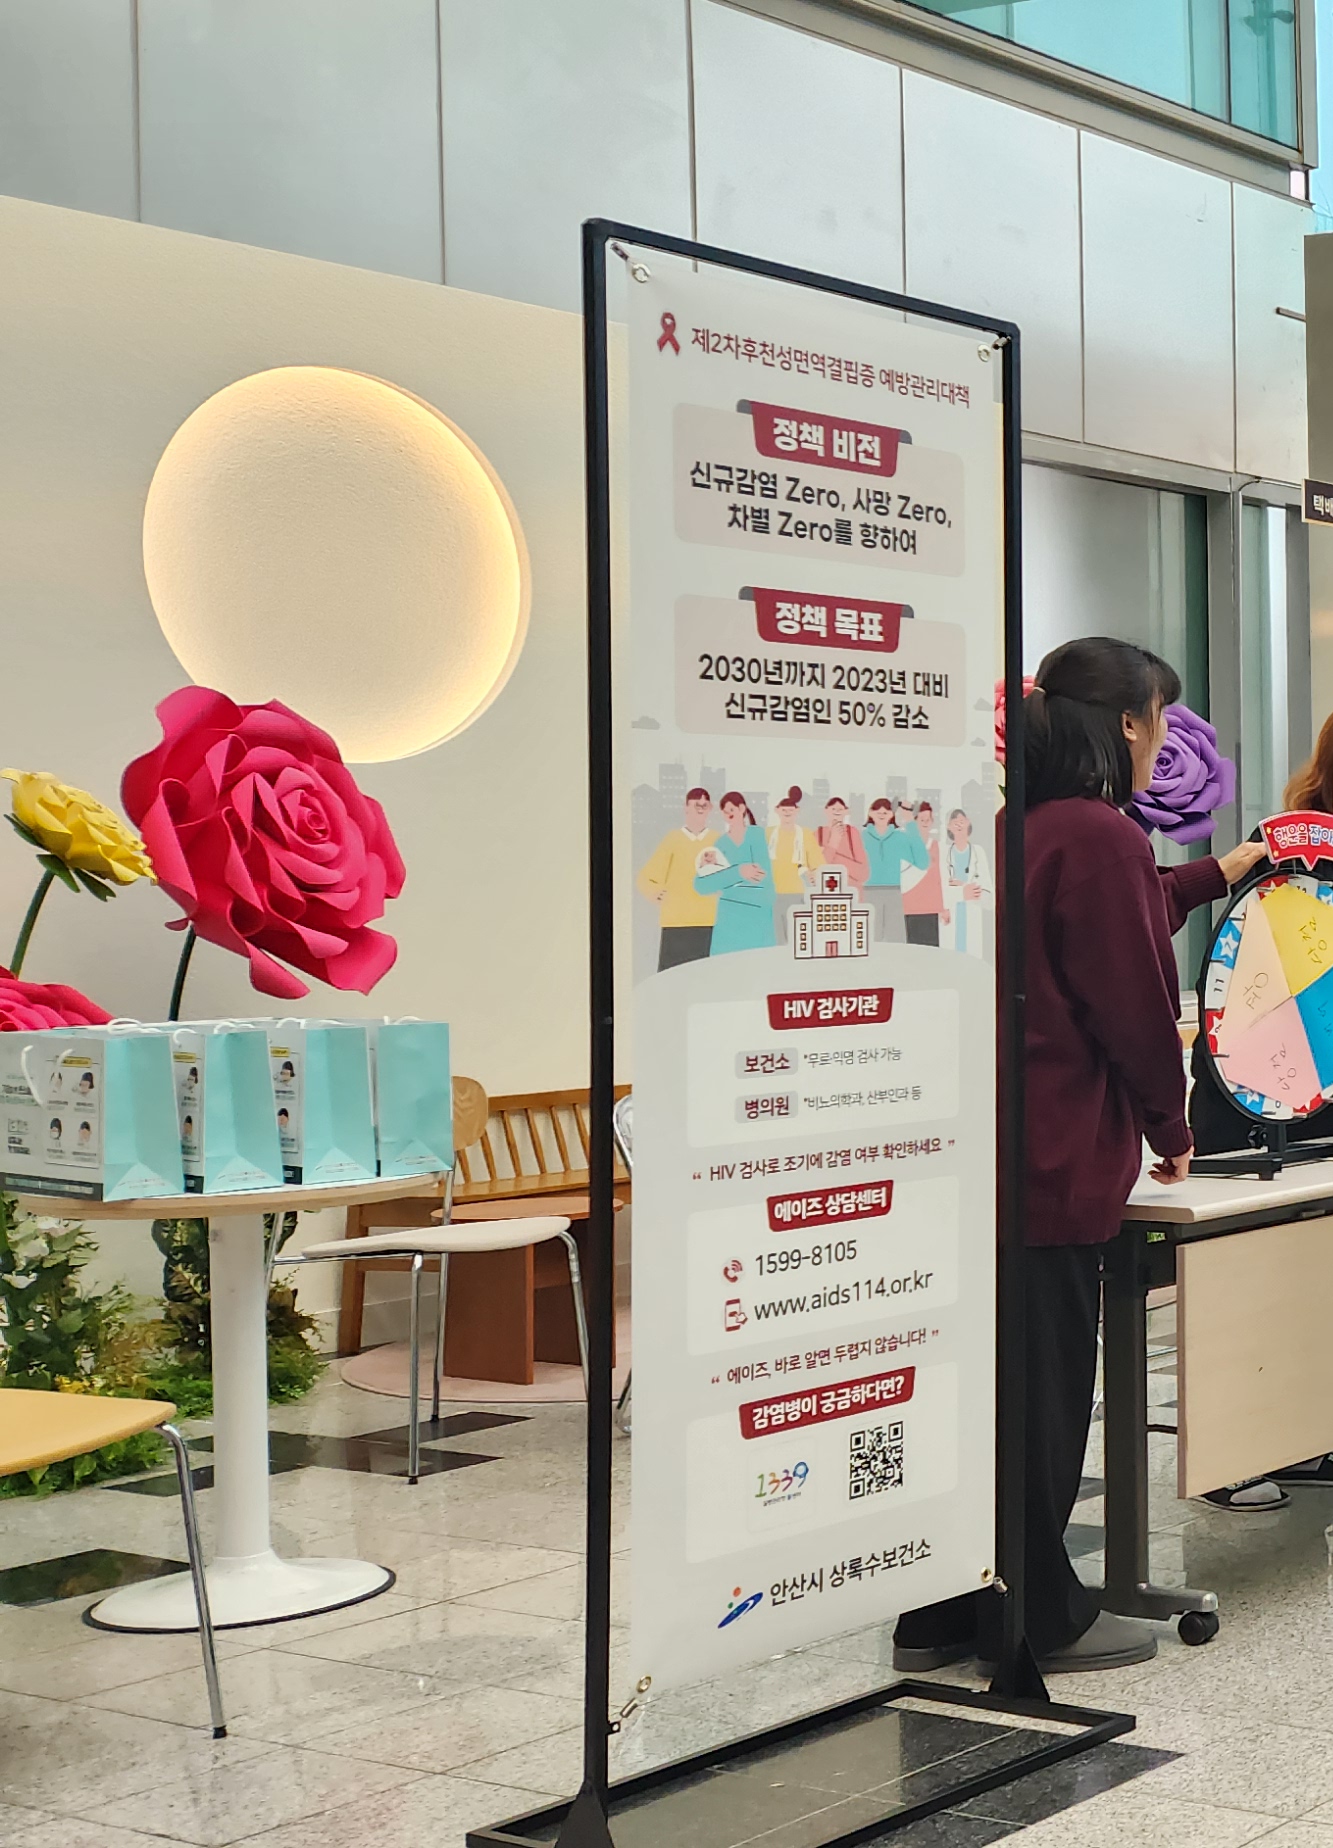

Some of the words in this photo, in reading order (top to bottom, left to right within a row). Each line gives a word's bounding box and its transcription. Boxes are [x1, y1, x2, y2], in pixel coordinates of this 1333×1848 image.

[691, 327, 876, 389] 제2차후천성면역결핍증
[878, 368, 971, 408] 예방관리대책
[772, 417, 825, 457] 정책
[832, 430, 881, 467] 비전
[690, 461, 778, 500] 신규감염
[785, 476, 846, 512] Zero,
[852, 487, 892, 517] 사망
[897, 494, 952, 528] Zero,
[727, 503, 771, 535] 차별
[777, 510, 854, 547] Zero를
[859, 522, 918, 555] 향하여
[774, 601, 827, 635] 정책
[834, 608, 885, 642] 목표
[698, 654, 826, 689] 2030년까지
[832, 665, 907, 696] 2023년
[912, 671, 949, 699] 대비
[724, 697, 832, 724] 신규감염인
[837, 702, 886, 727] 50%
[892, 704, 930, 731] 감소
[1274, 824, 1308, 849] 행운을
[783, 999, 815, 1019] HIV
[816, 994, 880, 1020] 검사기관
[744, 1052, 791, 1074] 보건소
[857, 1048, 879, 1064] 검사
[880, 1046, 902, 1061] 가능
[744, 1095, 790, 1120] 병의원
[911, 1085, 922, 1101] 등
[709, 1164, 735, 1182] HIV
[740, 1157, 780, 1179] 검사로
[783, 1150, 823, 1172] 조기에
[826, 1148, 851, 1168] 감염
[854, 1145, 880, 1164] 여부
[882, 1137, 942, 1161] 확인하세요
[774, 1196, 824, 1223] 에이즈
[825, 1187, 888, 1214] 상담센터
[755, 1239, 857, 1276] 1599-8105
[754, 1269, 934, 1321] www.aids114.or.kr
[727, 1364, 772, 1385] 에이즈,
[775, 1355, 802, 1375] 바로
[804, 1349, 831, 1369] 알면
[834, 1340, 872, 1363] 두렵지
[874, 1327, 927, 1355] 않습니다!
[752, 1394, 818, 1430] 감염병이
[820, 1375, 906, 1414] 궁금하다면?
[755, 1461, 810, 1498] 1339
[770, 1567, 824, 1606] 안산시
[829, 1538, 932, 1588] 상록수보건소
